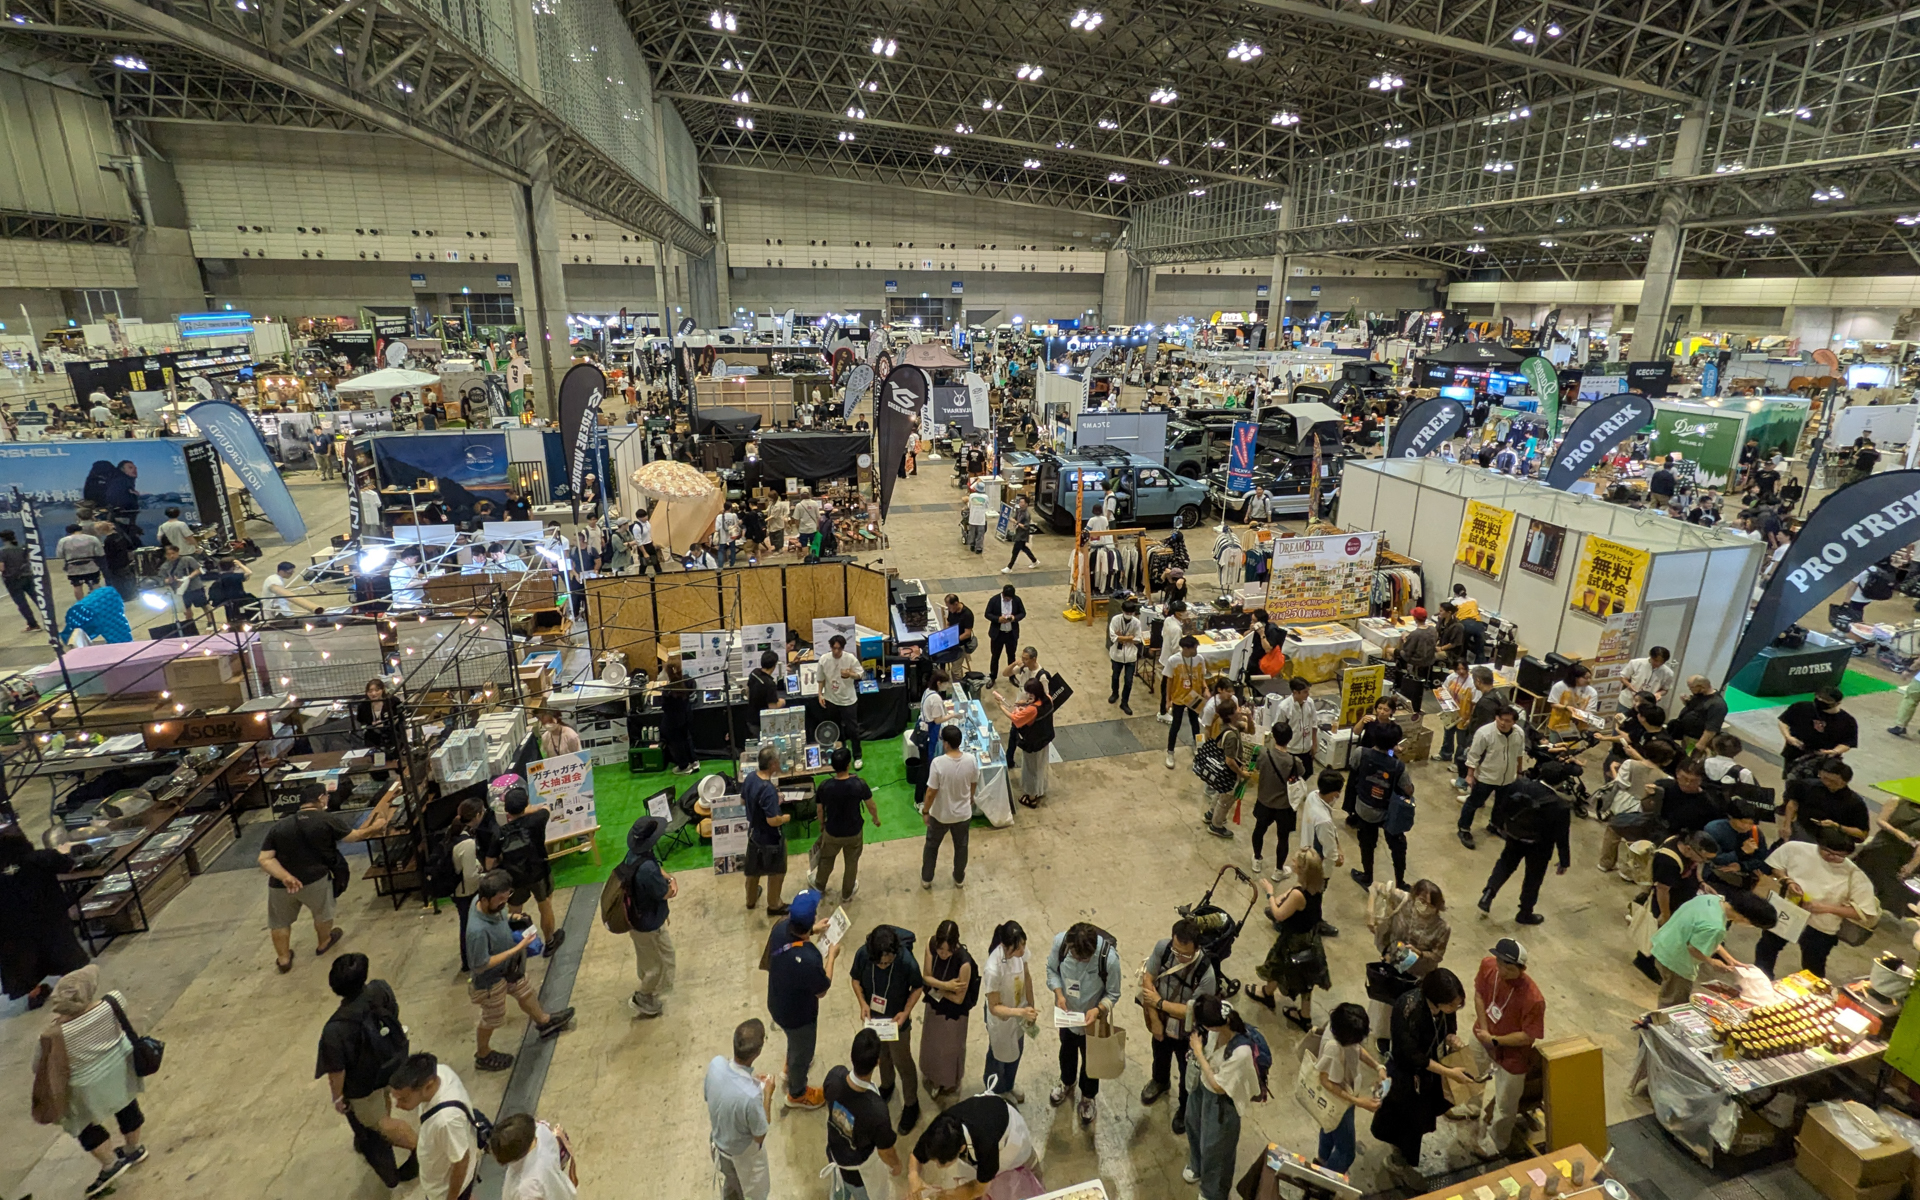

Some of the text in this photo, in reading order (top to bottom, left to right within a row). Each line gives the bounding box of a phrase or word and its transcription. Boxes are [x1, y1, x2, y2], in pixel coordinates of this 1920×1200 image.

[1635, 368, 1654, 376] ICECO
[1561, 403, 1642, 472] PRO TREK
[205, 443, 235, 541] HYPERSHELL
[1474, 511, 1504, 524] クラフトビール
[1471, 517, 1502, 540] 無料
[1468, 532, 1499, 552] 試飲会
[1600, 542, 1619, 552] CRAFT
[1595, 548, 1636, 566] クラフトビール
[1521, 561, 1555, 578] SMART TAP
[1592, 556, 1632, 586] 無料
[1786, 542, 1847, 593] PRO
[1586, 573, 1629, 599] 試飲会
[1788, 662, 1833, 676] PRO TREK
[1350, 680, 1377, 697] 無料
[1347, 695, 1376, 707] 試飲会
[533, 763, 587, 781] ガチャガチャ
[540, 772, 582, 790] 大抽選会
